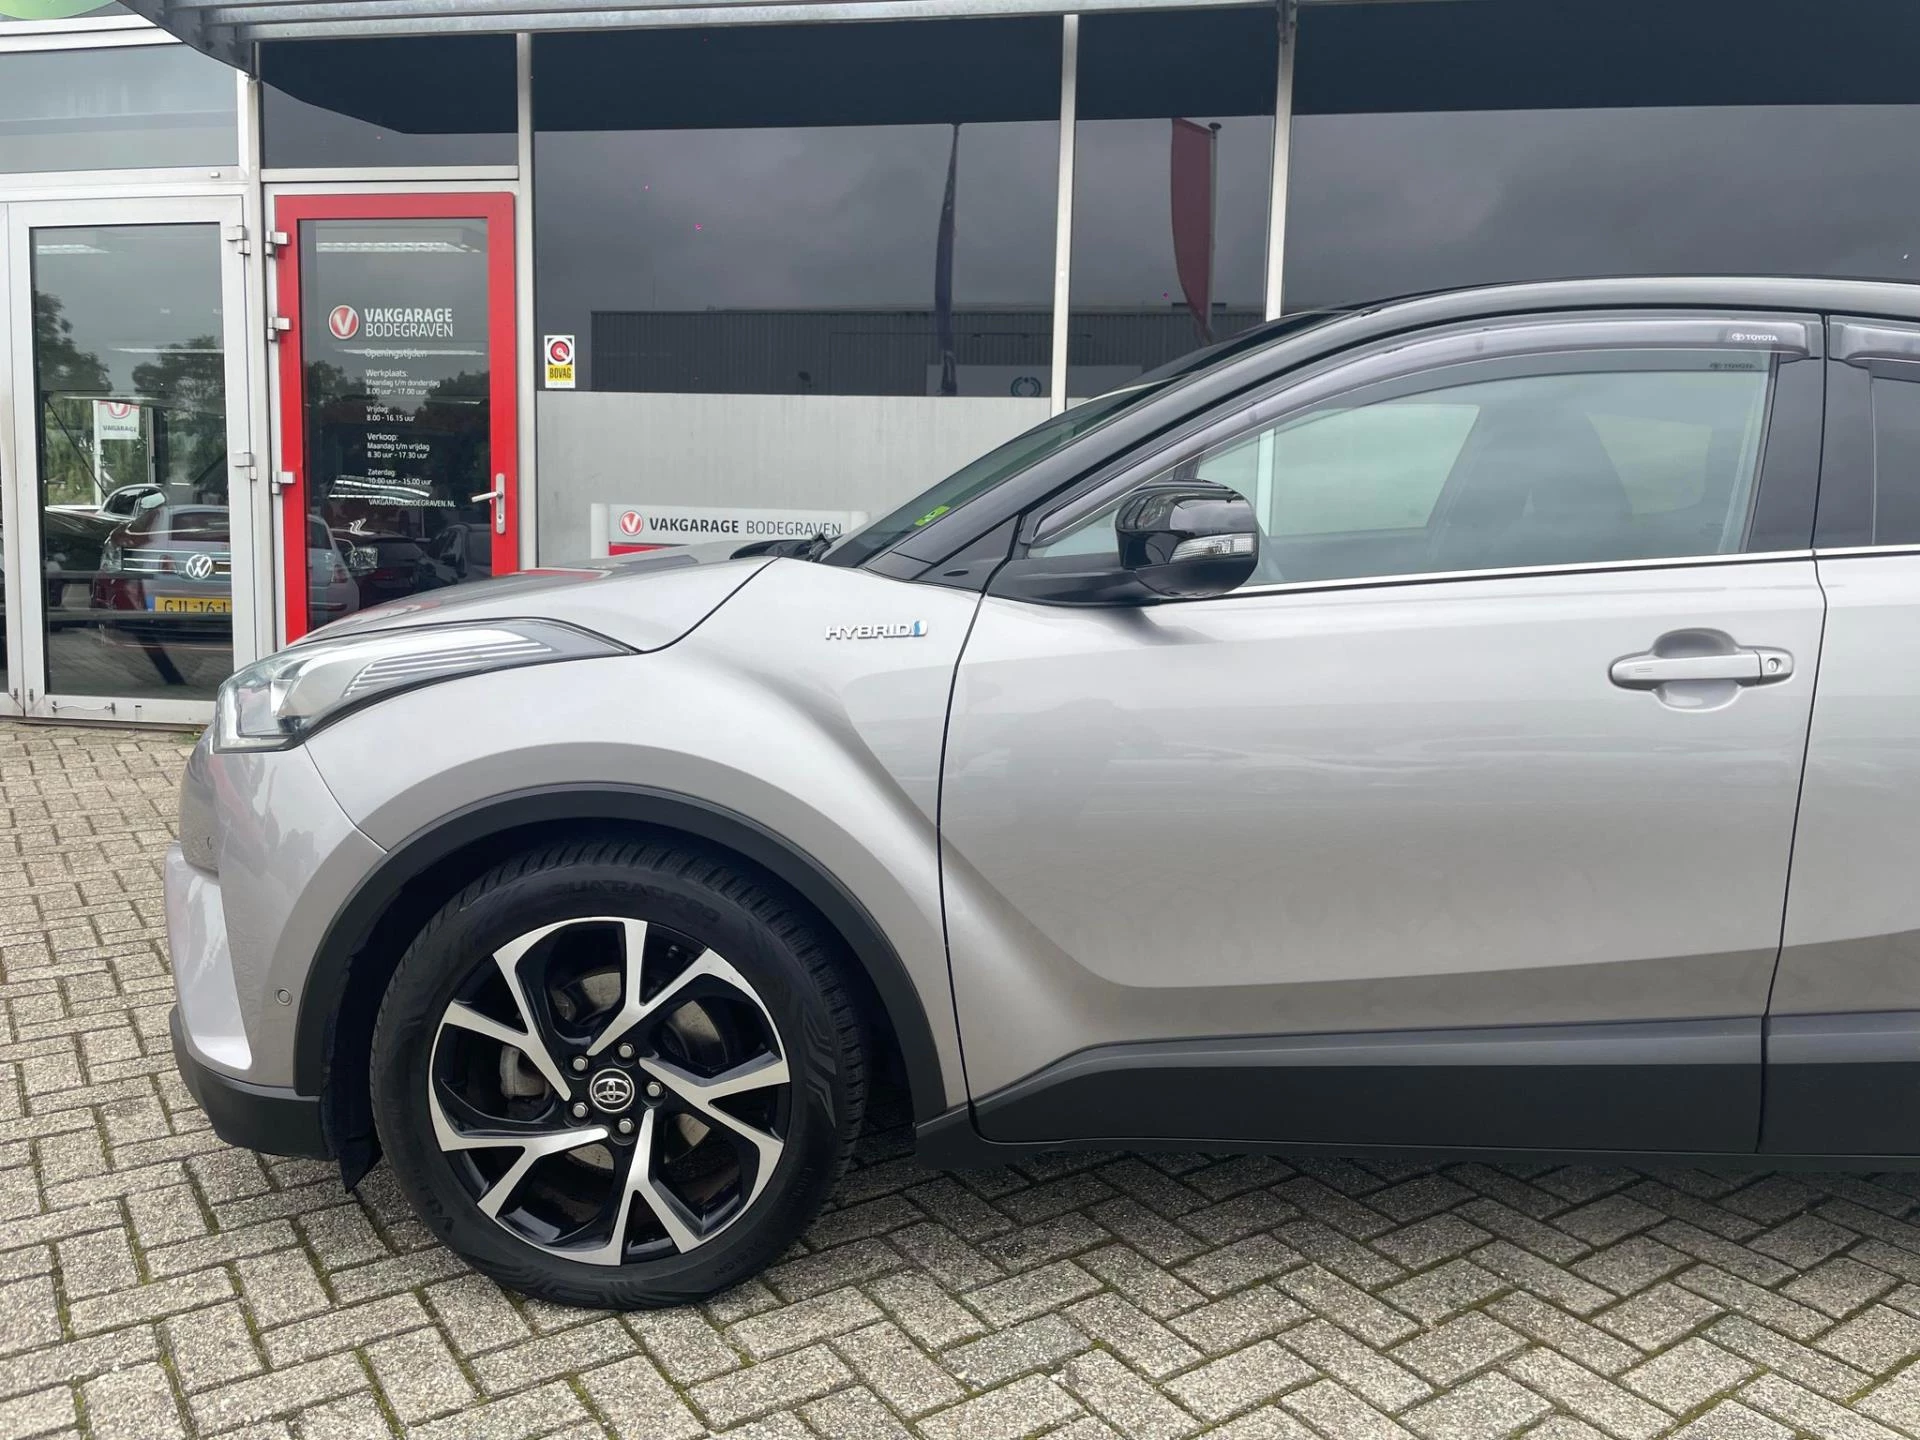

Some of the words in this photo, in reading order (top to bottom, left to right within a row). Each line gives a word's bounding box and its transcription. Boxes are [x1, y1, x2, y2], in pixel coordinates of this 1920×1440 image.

[364, 308, 453, 322] VAKGARAGE
[365, 322, 454, 337] BODEGRAVEN
[365, 369, 408, 378] Werkplaats:
[549, 367, 572, 379] BOVAG
[366, 380, 394, 388] Maandag
[407, 380, 441, 389] donderdag
[386, 414, 403, 422] 16.15
[367, 442, 394, 451] Maandag
[408, 443, 430, 451] vrijdag
[650, 517, 739, 533] VAKGARAGE
[746, 520, 842, 536] BODEGRAVEN
[825, 623, 912, 640] HYBRID
